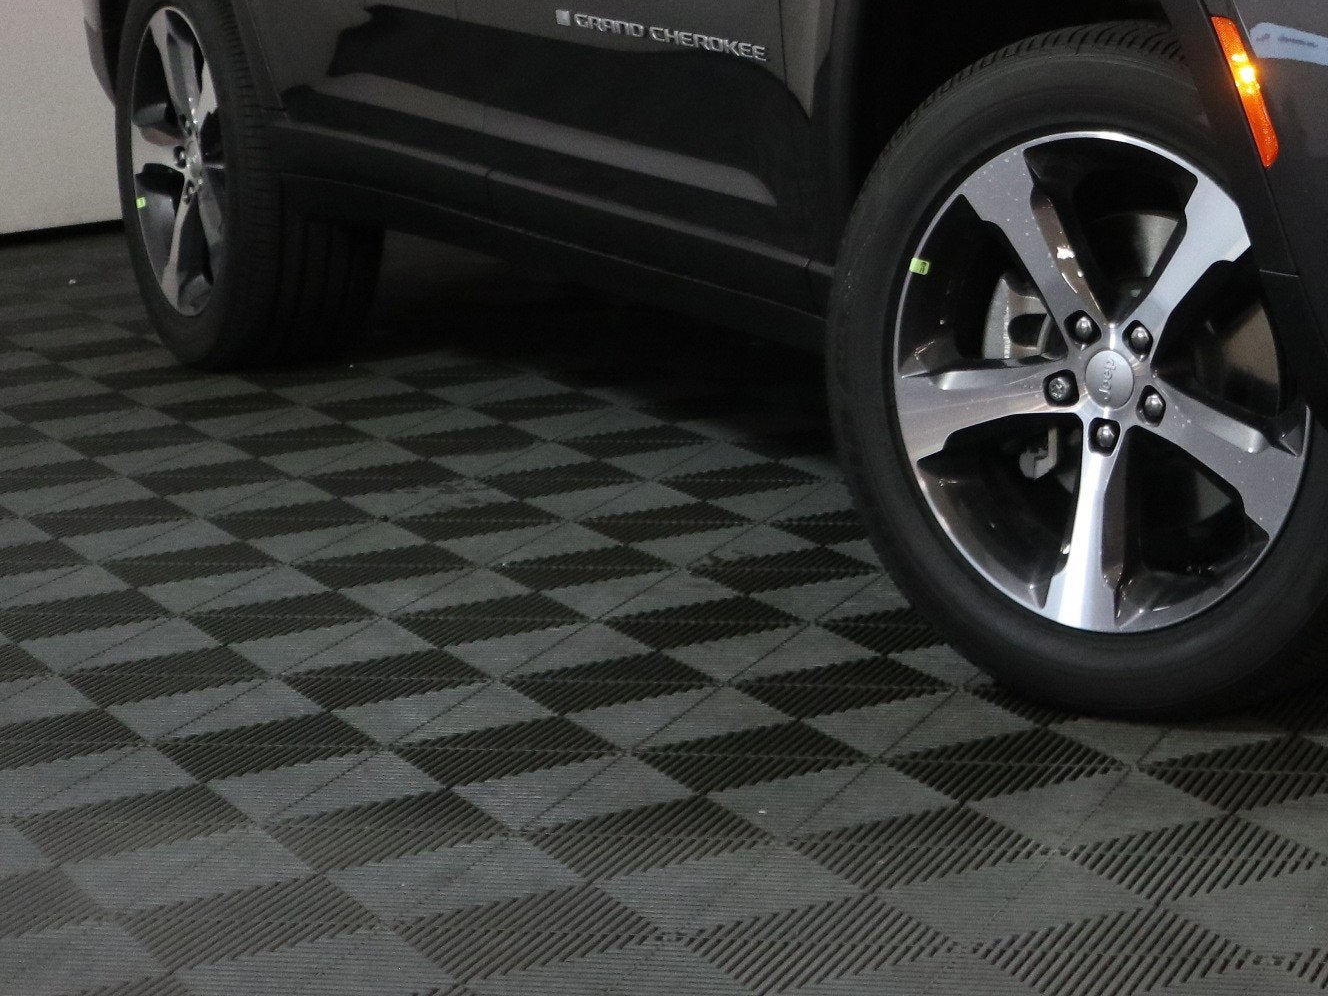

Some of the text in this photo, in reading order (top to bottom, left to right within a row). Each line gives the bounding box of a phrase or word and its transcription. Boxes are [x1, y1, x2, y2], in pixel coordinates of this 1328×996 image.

[573, 13, 767, 62] GRAND CHEROKEE
[1098, 358, 1117, 402] Jeep
